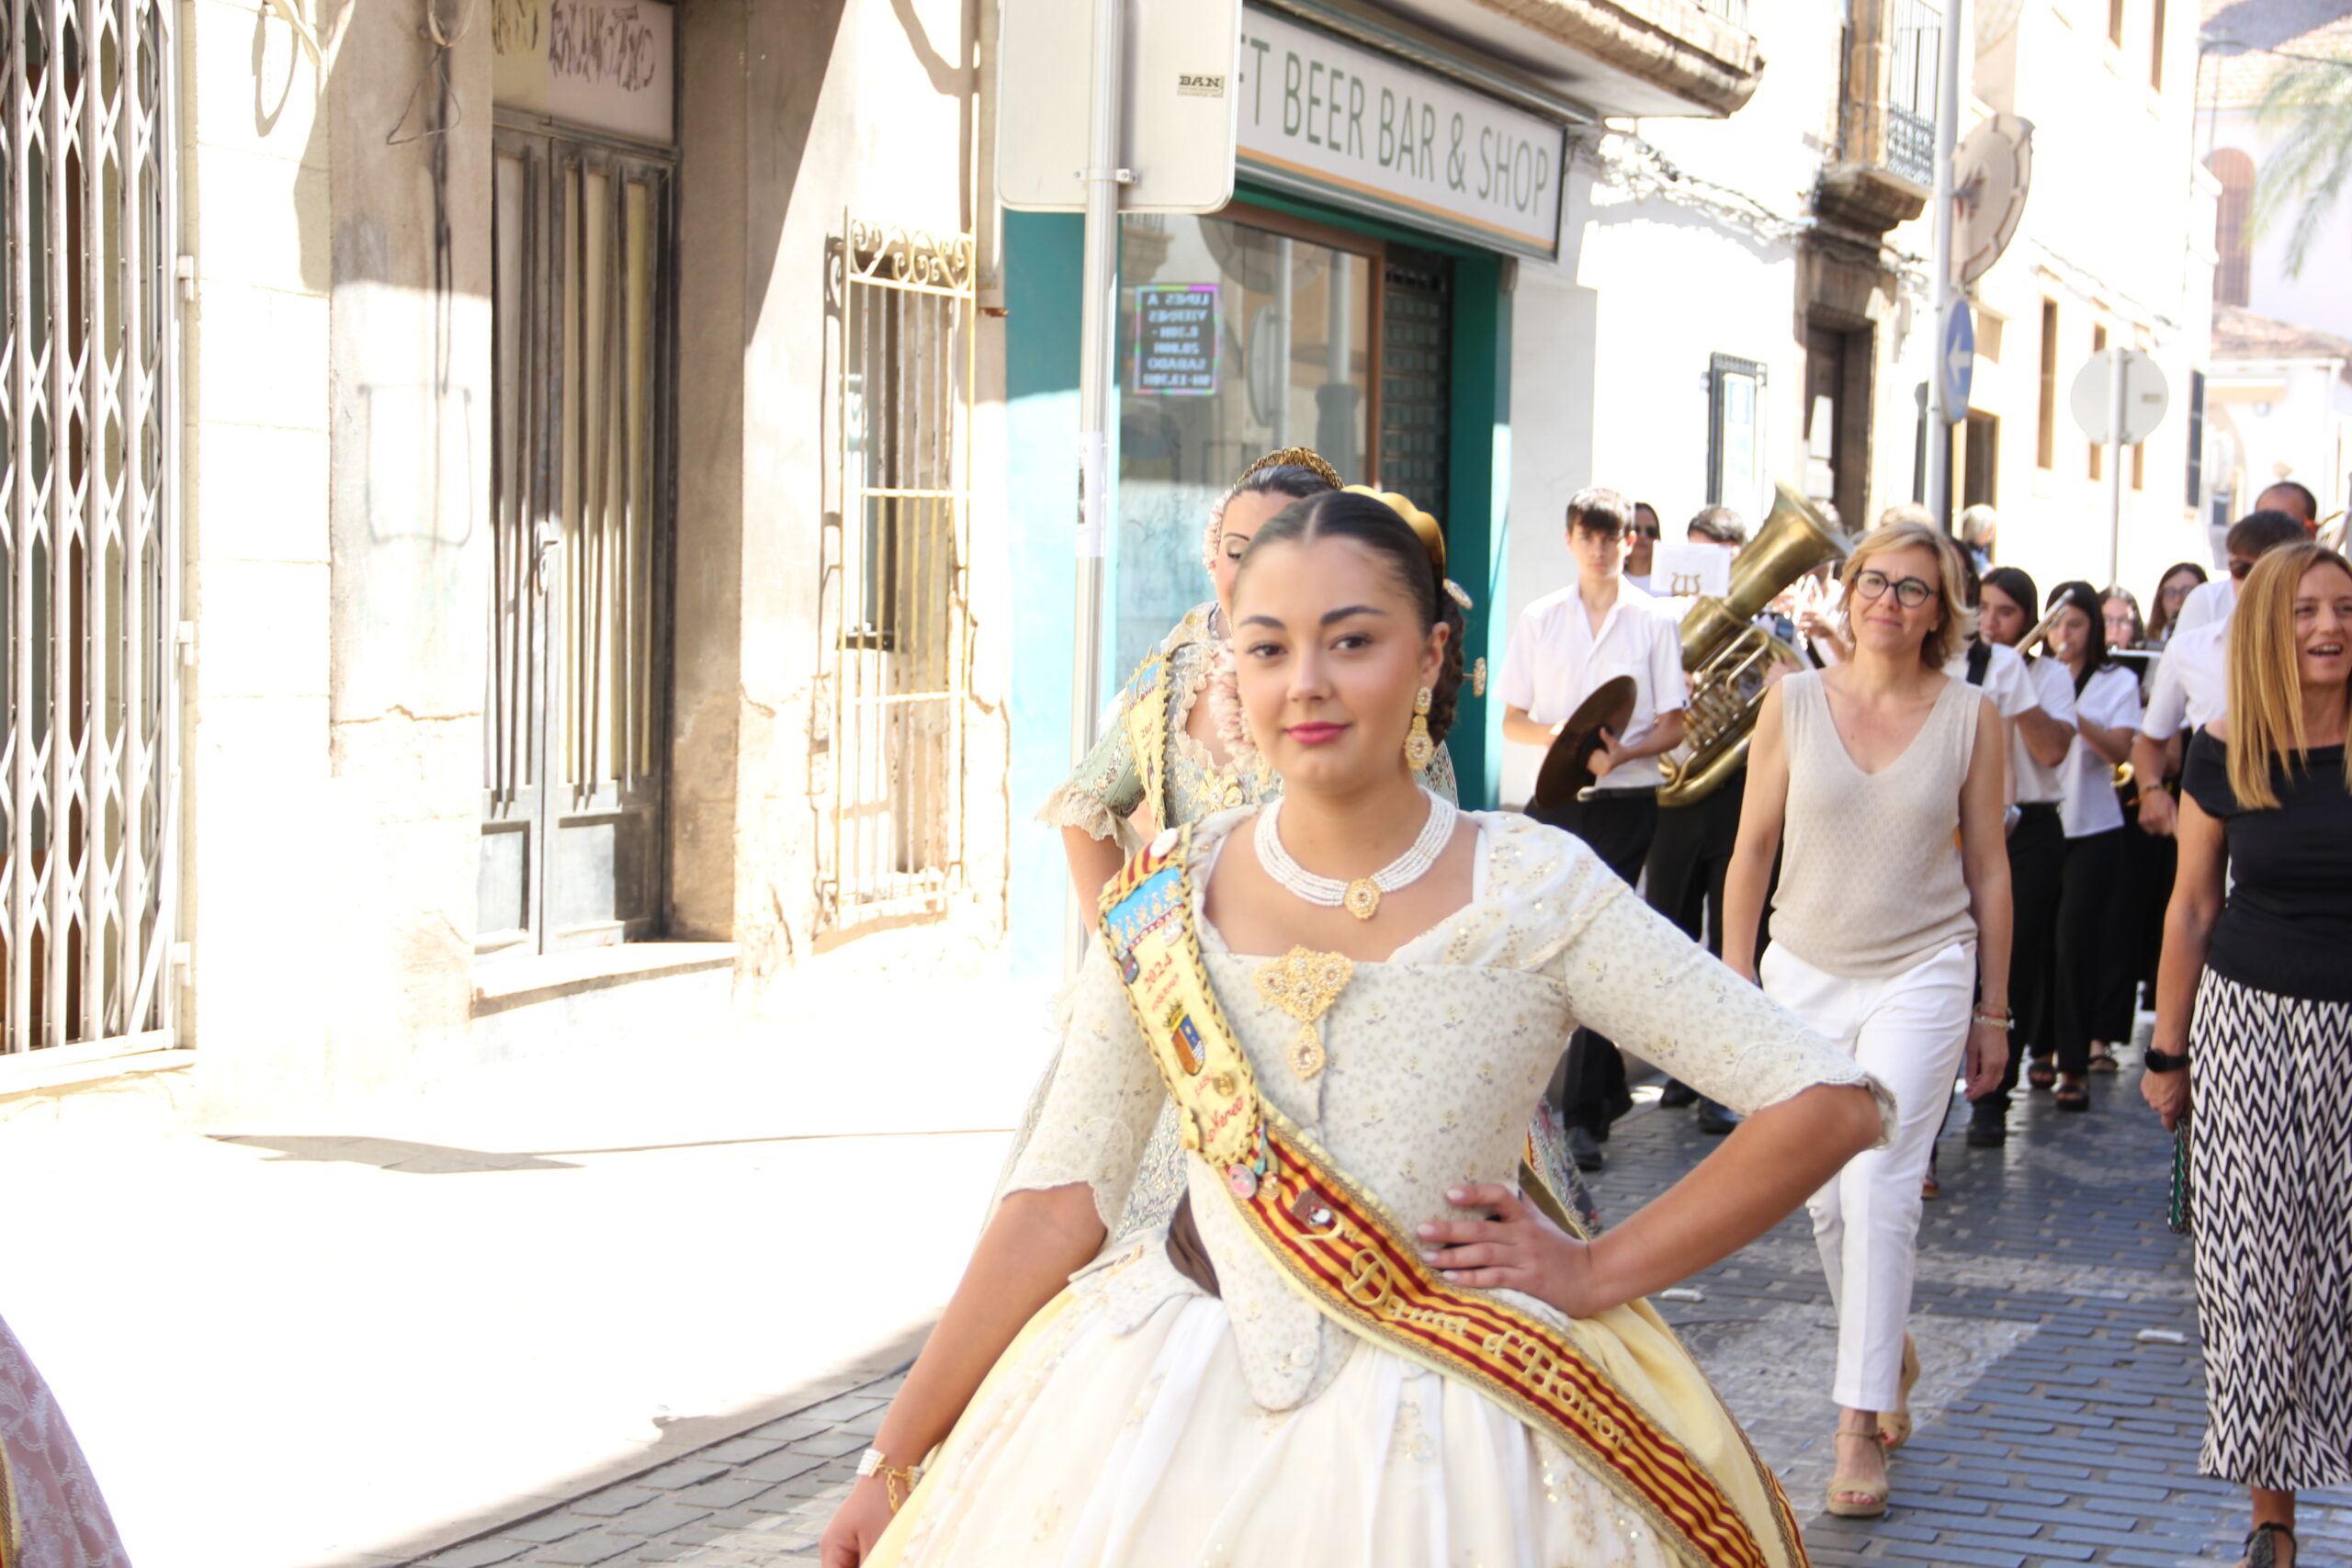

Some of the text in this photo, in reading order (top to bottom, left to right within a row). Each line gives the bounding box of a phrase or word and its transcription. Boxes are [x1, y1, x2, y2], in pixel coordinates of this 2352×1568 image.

[1179, 75, 1220, 87] BAN
[1283, 51, 1365, 160] BEER
[1378, 86, 1434, 183] BAR
[1446, 111, 1466, 194] &
[1477, 125, 1549, 217] SHOP
[1342, 1247, 1471, 1339] Dama
